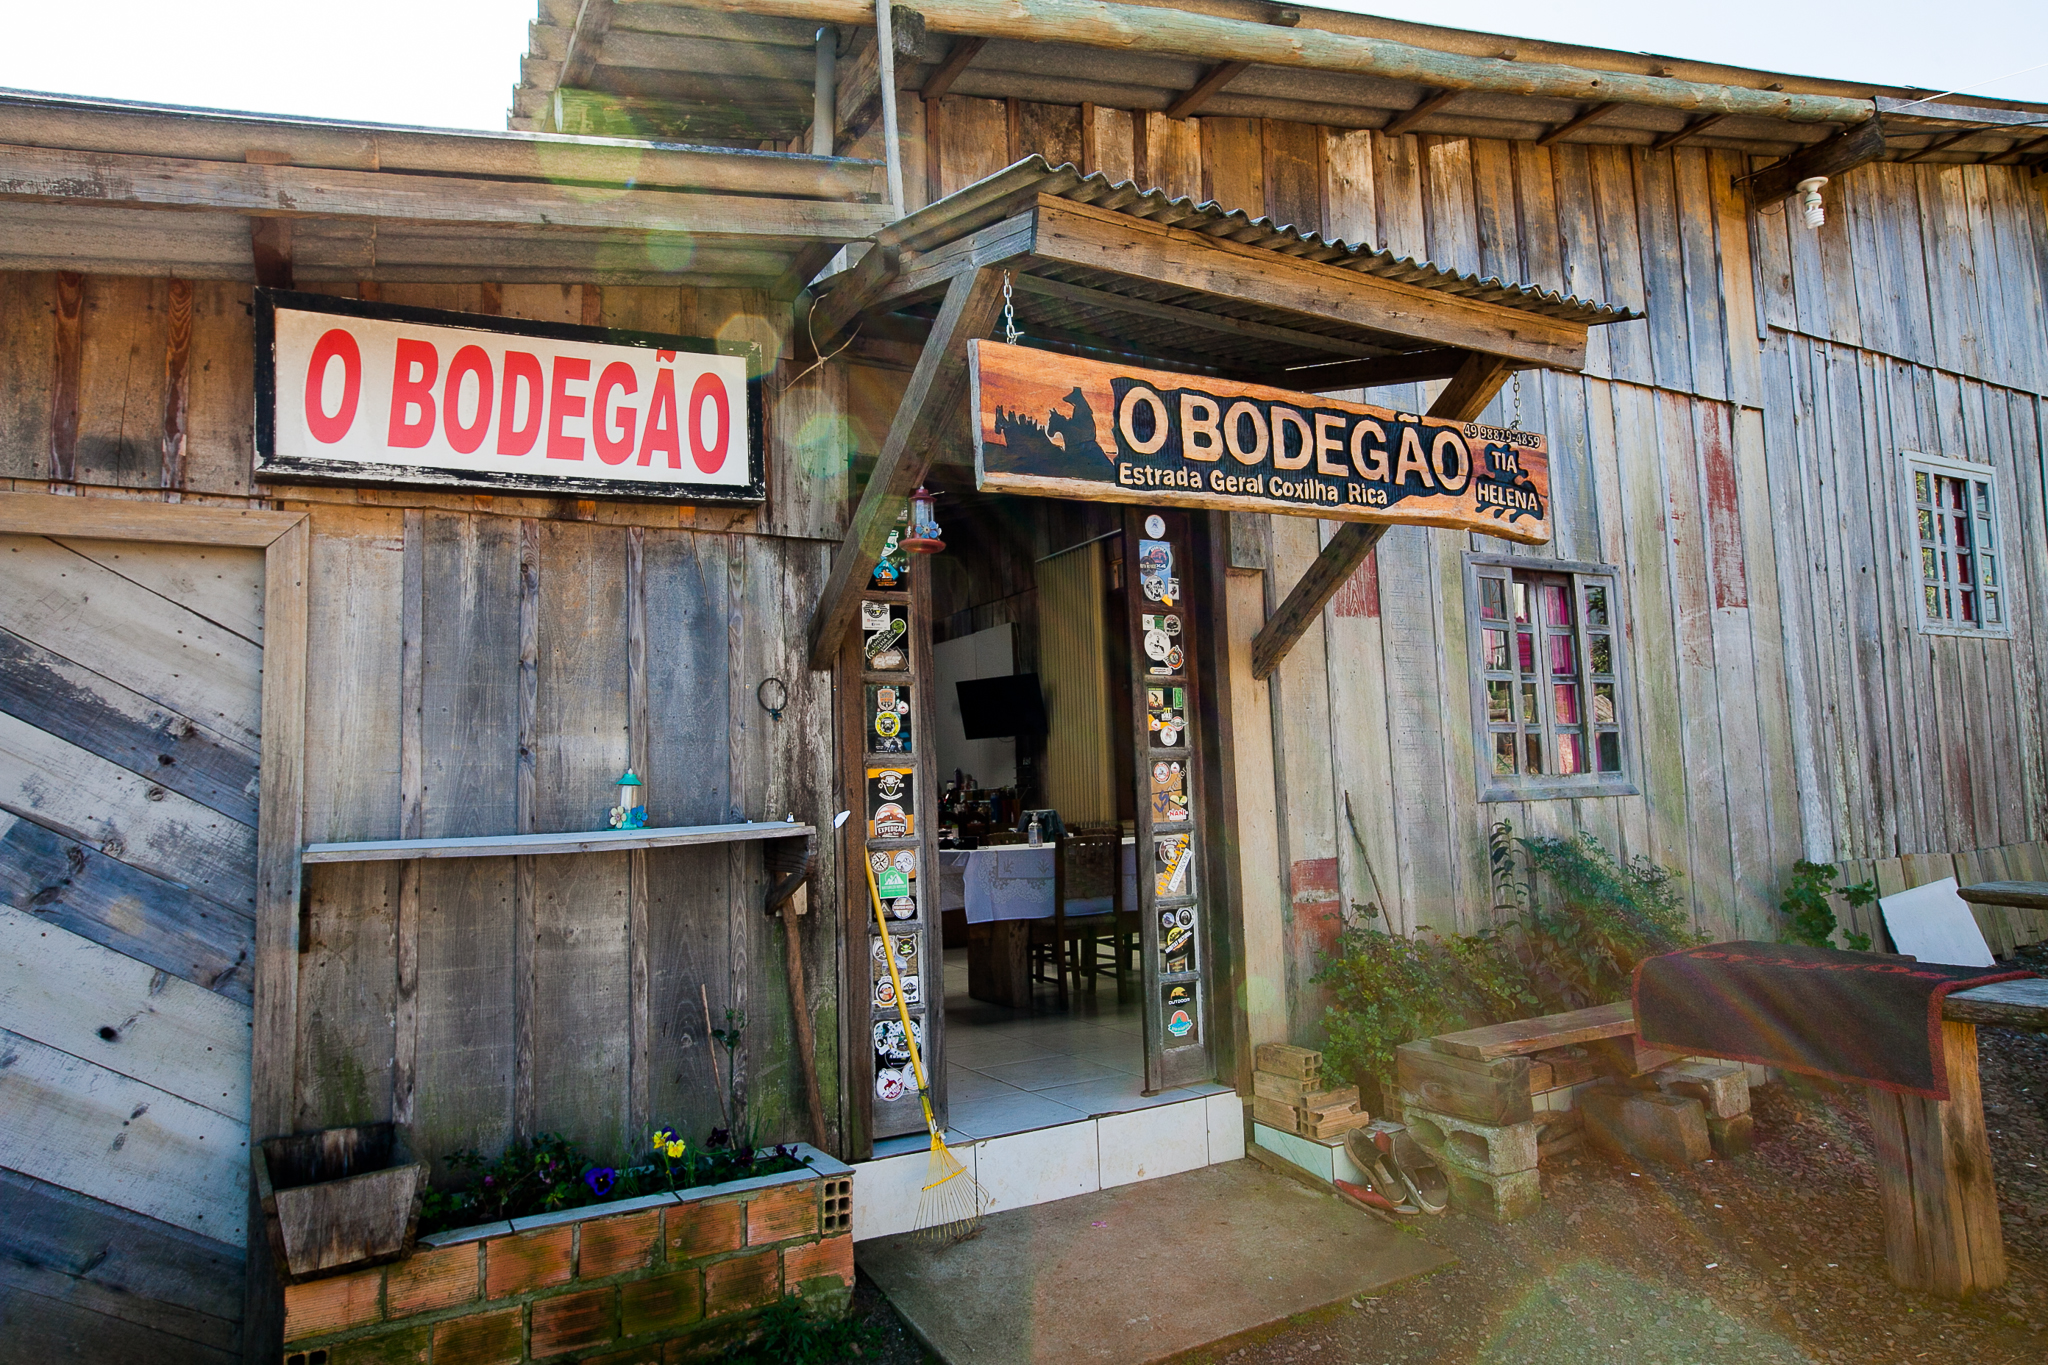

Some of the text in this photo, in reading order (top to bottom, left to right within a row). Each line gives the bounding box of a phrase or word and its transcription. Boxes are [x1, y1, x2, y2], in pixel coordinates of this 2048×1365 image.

[305, 328, 730, 475] O BODEGÃO
[1119, 386, 1470, 491] O BODEGÃO
[1464, 424, 1540, 448] 49 98829-4859
[1491, 451, 1518, 474] TIA
[1119, 462, 1388, 505] Estrada Geral Coxilha Rica
[1477, 482, 1538, 511] HELENA
[1167, 766, 1188, 793] Tractor
